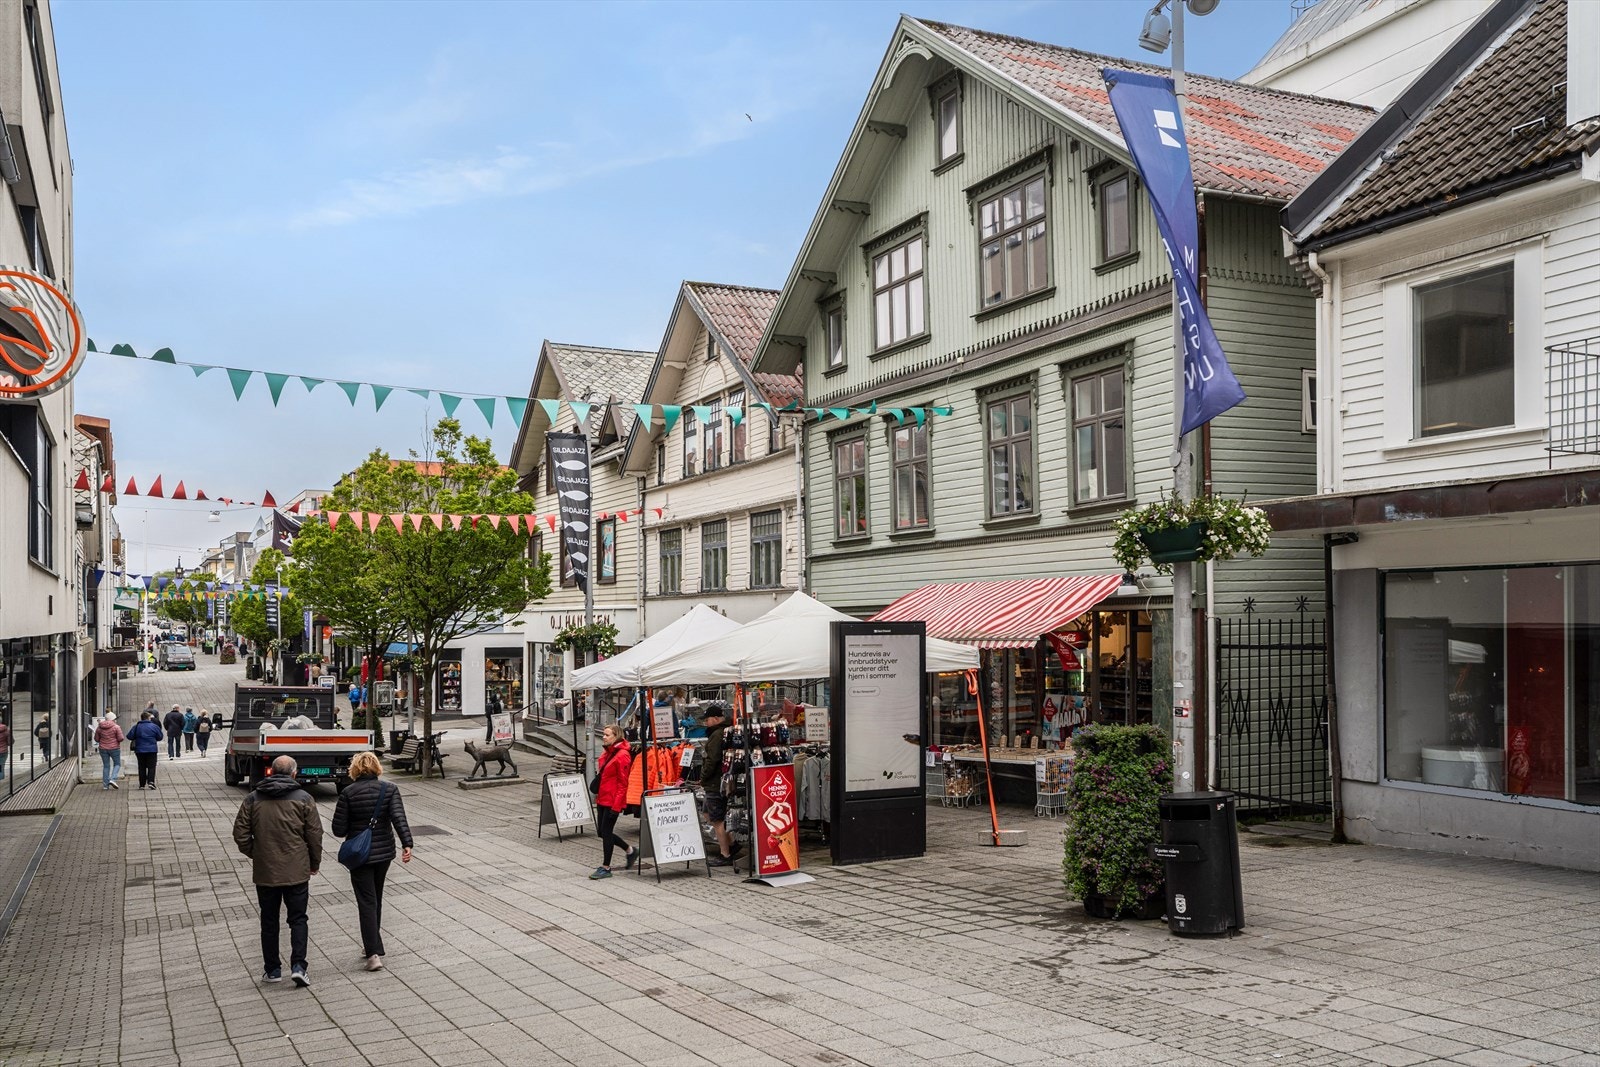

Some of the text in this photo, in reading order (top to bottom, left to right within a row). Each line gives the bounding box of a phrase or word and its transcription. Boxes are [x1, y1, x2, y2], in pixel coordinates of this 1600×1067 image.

[552, 446, 586, 455] SILDAJAZZ
[848, 650, 882, 658] Hundrevis
[848, 658, 898, 666] innbruddstyver
[848, 673, 865, 681] hjem
[768, 784, 788, 792] HENNIG
[657, 814, 689, 827] MAGNETS
